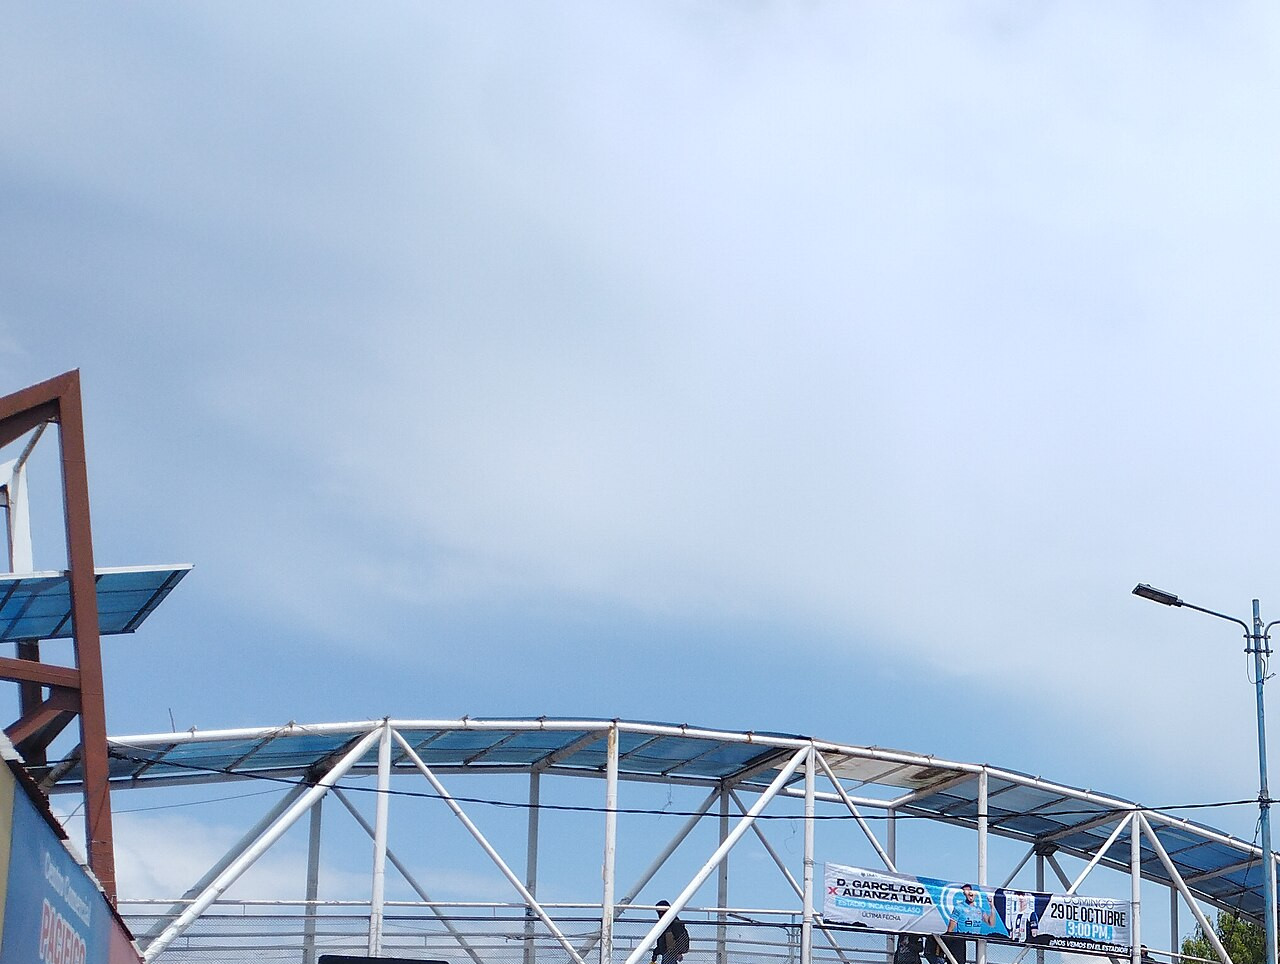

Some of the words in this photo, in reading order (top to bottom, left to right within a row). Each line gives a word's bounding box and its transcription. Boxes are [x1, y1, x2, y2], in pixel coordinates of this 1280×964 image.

[836, 879, 849, 887] D.
[852, 880, 925, 895] GARCILASO
[843, 888, 899, 902] ALIANZA
[903, 894, 932, 905] LIMA
[1063, 897, 1115, 909] DOMINGO
[838, 899, 865, 908] ESTADIO
[885, 904, 921, 914] GARCILASO
[1050, 903, 1064, 920] 29
[1065, 905, 1079, 921] DE
[1081, 906, 1126, 928] OCTUBRE
[1067, 921, 1091, 937] 3:00
[1066, 941, 1086, 949] VEMOS
